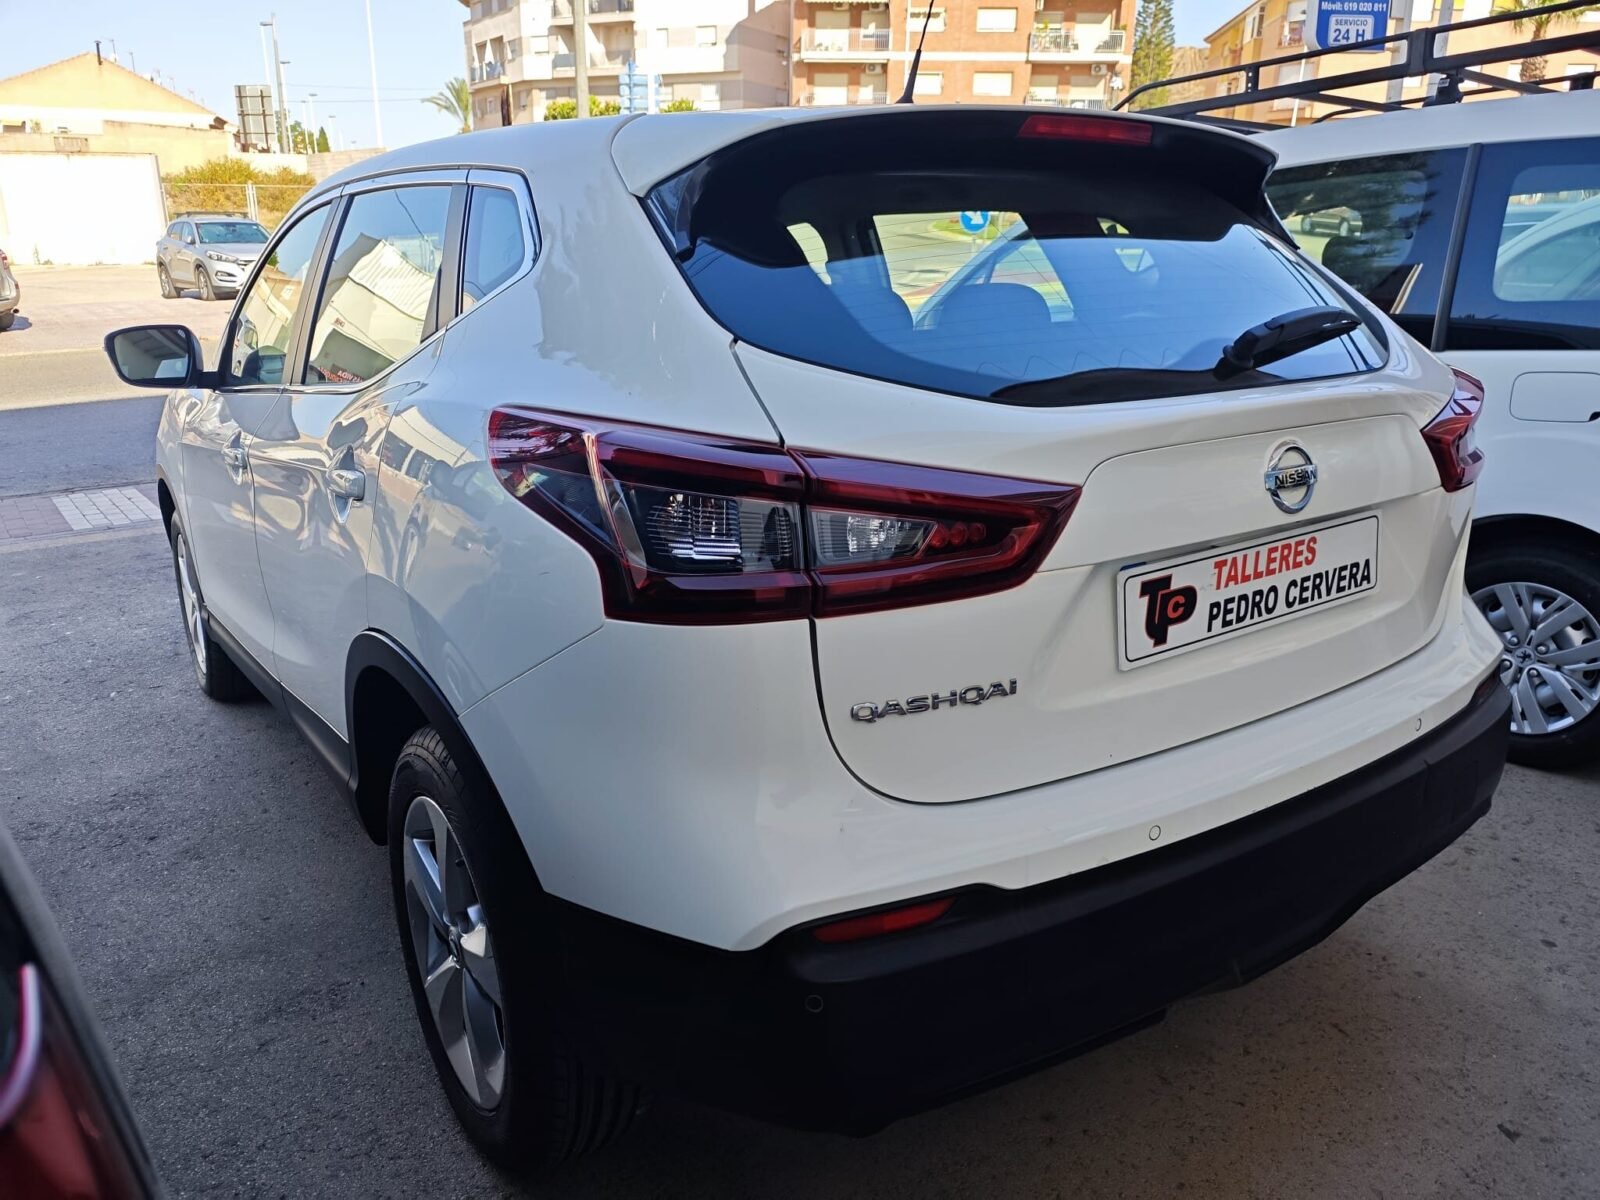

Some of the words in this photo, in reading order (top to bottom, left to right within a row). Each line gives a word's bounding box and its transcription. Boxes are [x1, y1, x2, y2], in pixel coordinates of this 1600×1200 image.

[1344, 2, 1358, 11] 619
[1358, 2, 1373, 12] 020
[1373, 3, 1387, 12] 811
[1335, 18, 1368, 26] SERVICIO
[1333, 28, 1350, 43] 24
[1355, 28, 1366, 43] H
[1274, 469, 1317, 487] NISSAN
[1213, 535, 1318, 591] TALLERES
[1207, 584, 1279, 634] PEDRO
[1284, 558, 1372, 608] CERVERA
[850, 677, 1017, 723] QASHQAI
